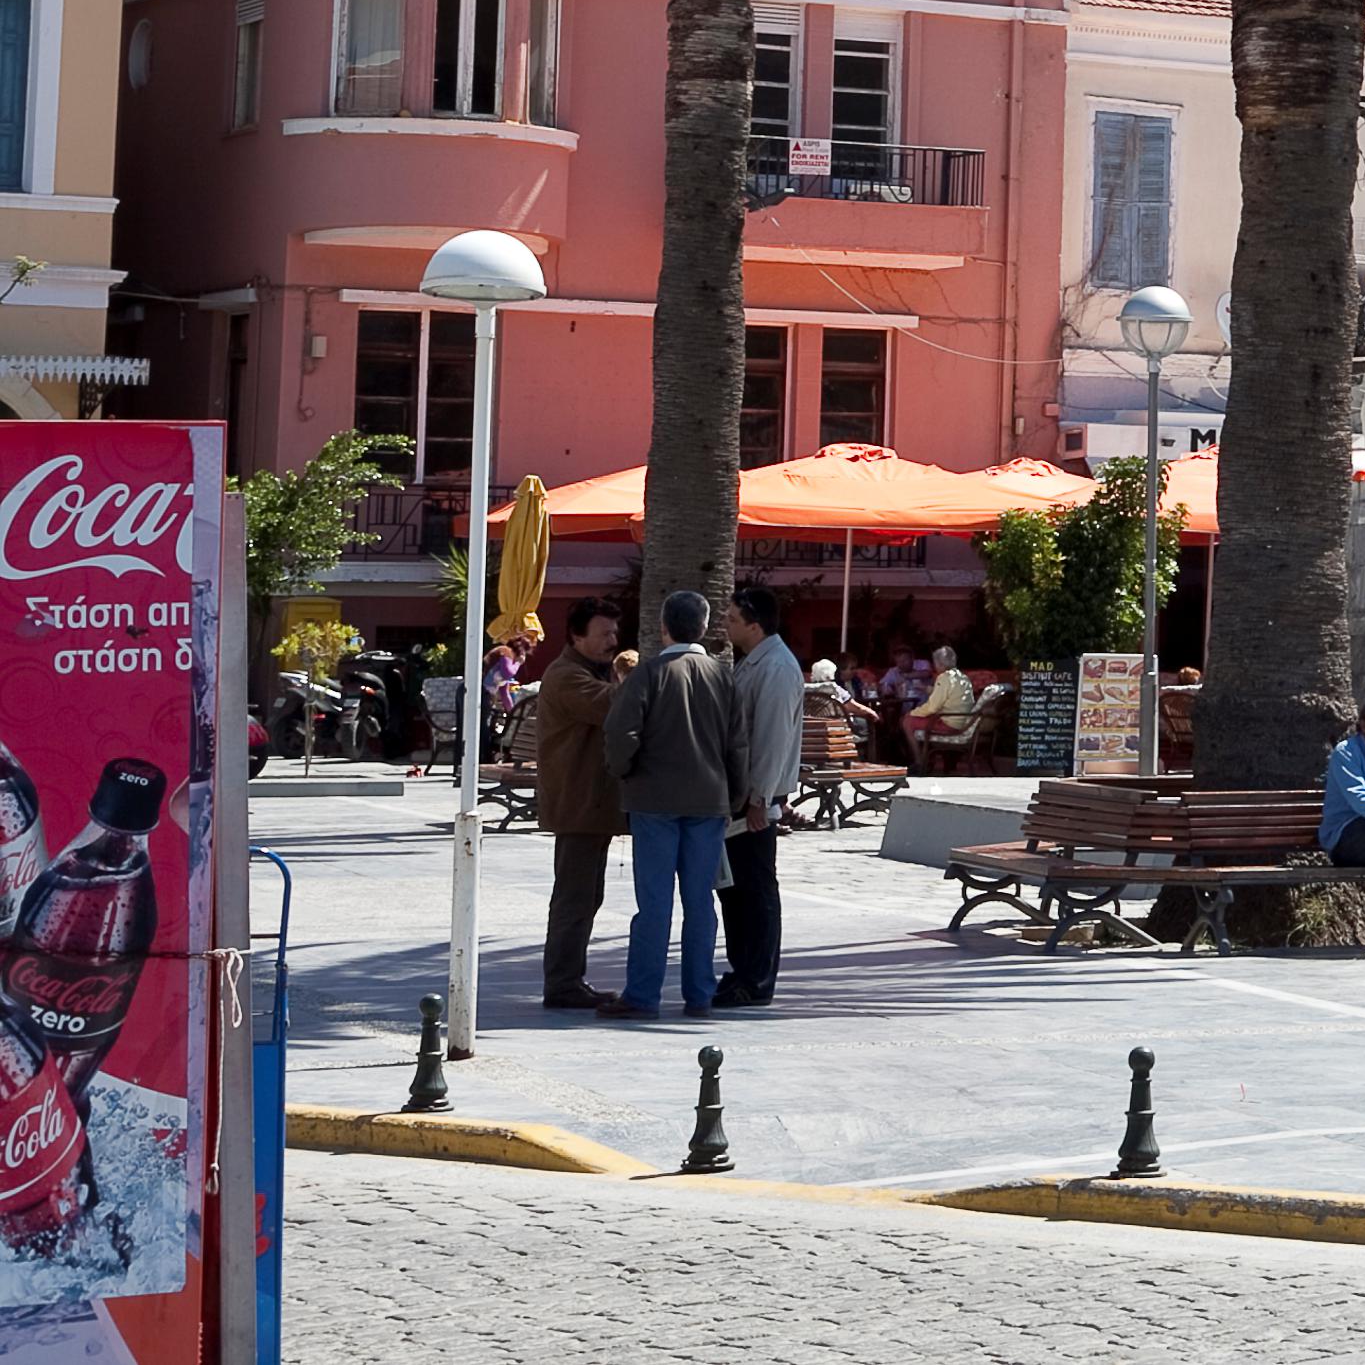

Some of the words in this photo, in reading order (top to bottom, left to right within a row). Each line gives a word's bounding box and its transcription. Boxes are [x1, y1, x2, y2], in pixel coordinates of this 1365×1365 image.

[25, 595, 135, 630] Στάση
[54, 639, 163, 674] στάση
[1030, 661, 1055, 672] MAD
[119, 772, 149, 786] zero
[30, 1004, 87, 1034] zero
